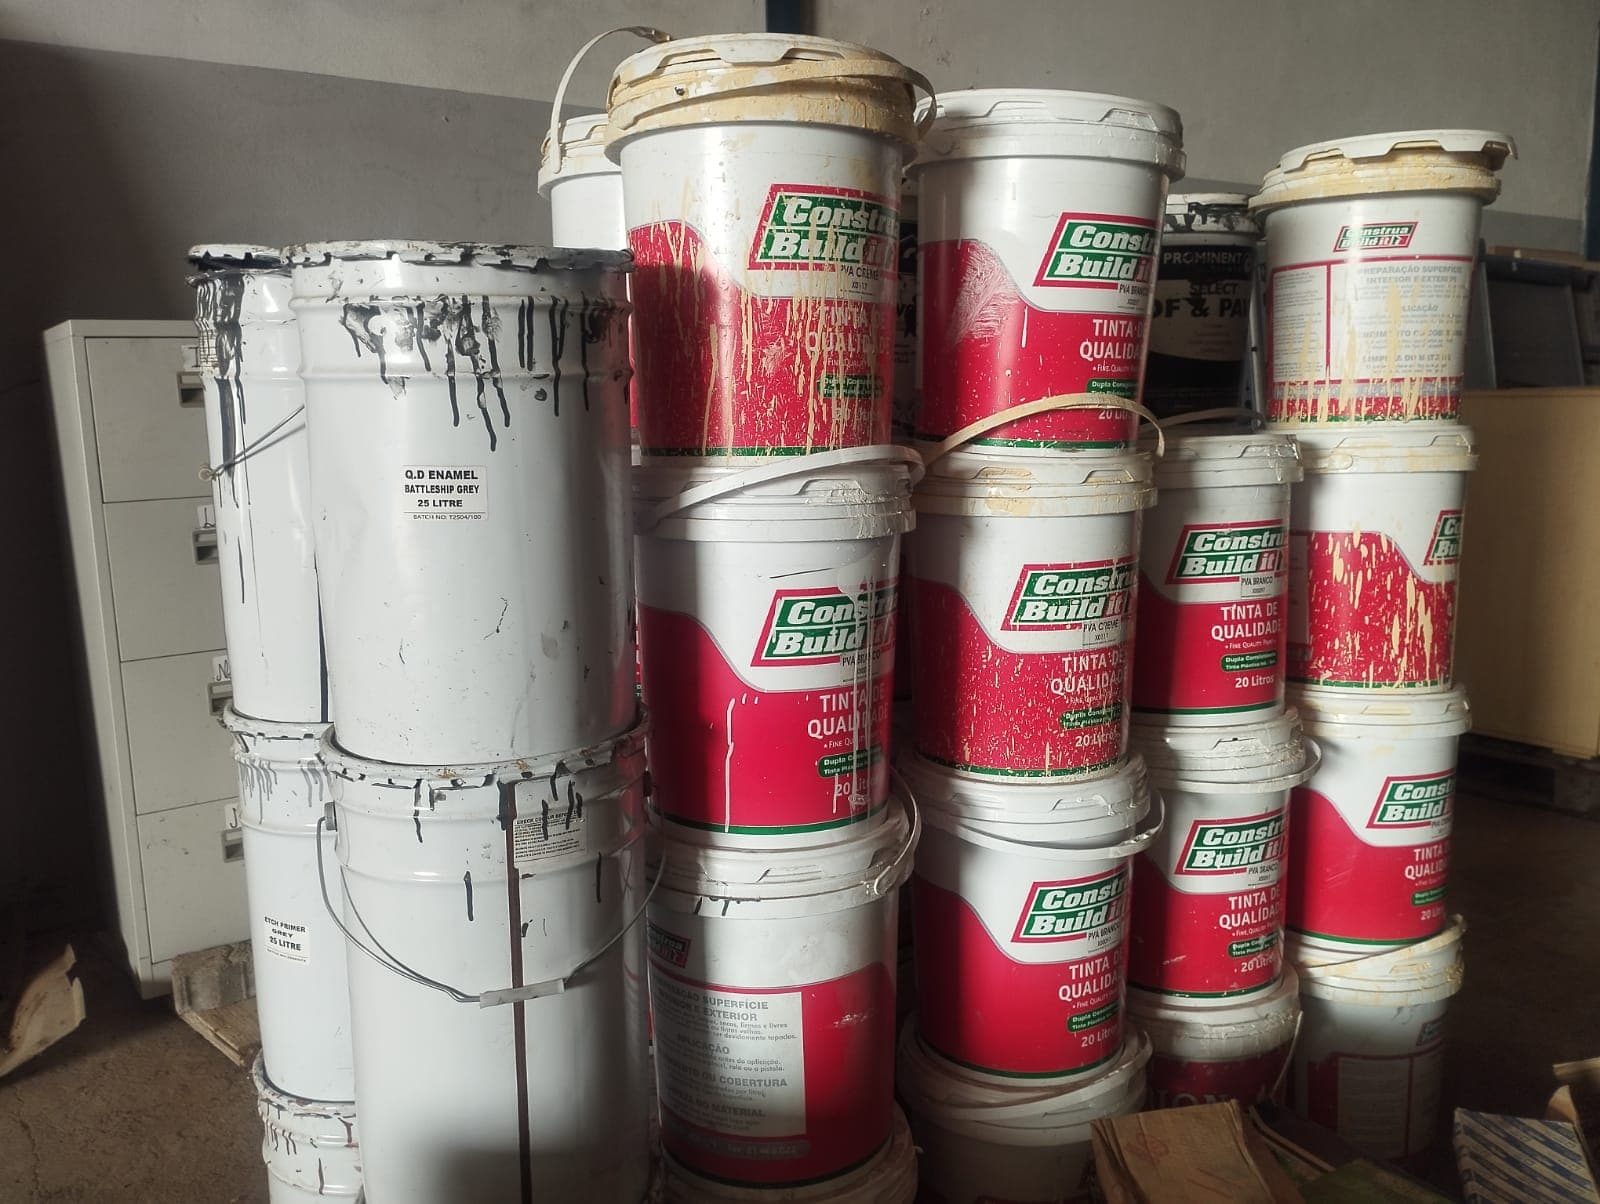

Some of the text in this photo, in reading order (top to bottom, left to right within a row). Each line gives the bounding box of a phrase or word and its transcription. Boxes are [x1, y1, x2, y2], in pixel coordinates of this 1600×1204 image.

[768, 231, 866, 261] Build
[1163, 251, 1243, 265] PROMINENT
[1053, 253, 1138, 280] Build
[1092, 319, 1134, 339] TINTA
[404, 469, 479, 480] Q.D ENAMEL
[404, 484, 480, 494] BATTLESHIP GREY
[417, 499, 463, 507] 25 LITRE
[1182, 552, 1276, 575] Build it
[1241, 575, 1275, 586] PVA BRANCO
[1020, 596, 1107, 621] Build
[1220, 603, 1262, 621] TINTA
[773, 625, 867, 655] Build
[1062, 653, 1108, 673] TINTA
[1225, 656, 1245, 664] Dupla
[1235, 674, 1275, 688] 20 Litros
[829, 740, 842, 749] FINE
[1075, 734, 1091, 748] 20
[824, 756, 846, 766] Dupla
[1382, 800, 1444, 821] Build
[1191, 844, 1266, 868] Build
[1413, 845, 1443, 862] TINTA
[1228, 891, 1267, 910] TINTA
[264, 916, 306, 933] ETCH PRIMER
[1029, 904, 1109, 934] Build
[271, 928, 294, 939] GREY
[1088, 929, 1100, 940] PVA
[269, 935, 302, 951] 25 LITRE
[1068, 956, 1110, 980] TINTA
[1241, 961, 1254, 973] 20
[703, 995, 769, 1011] SUPERFÍCIE
[1076, 1001, 1089, 1009] FINE
[704, 1009, 758, 1022] EXTERIOR
[769, 1021, 788, 1029] livres
[1081, 1034, 1095, 1048] 20
[719, 1074, 788, 1088] COBERTURA
